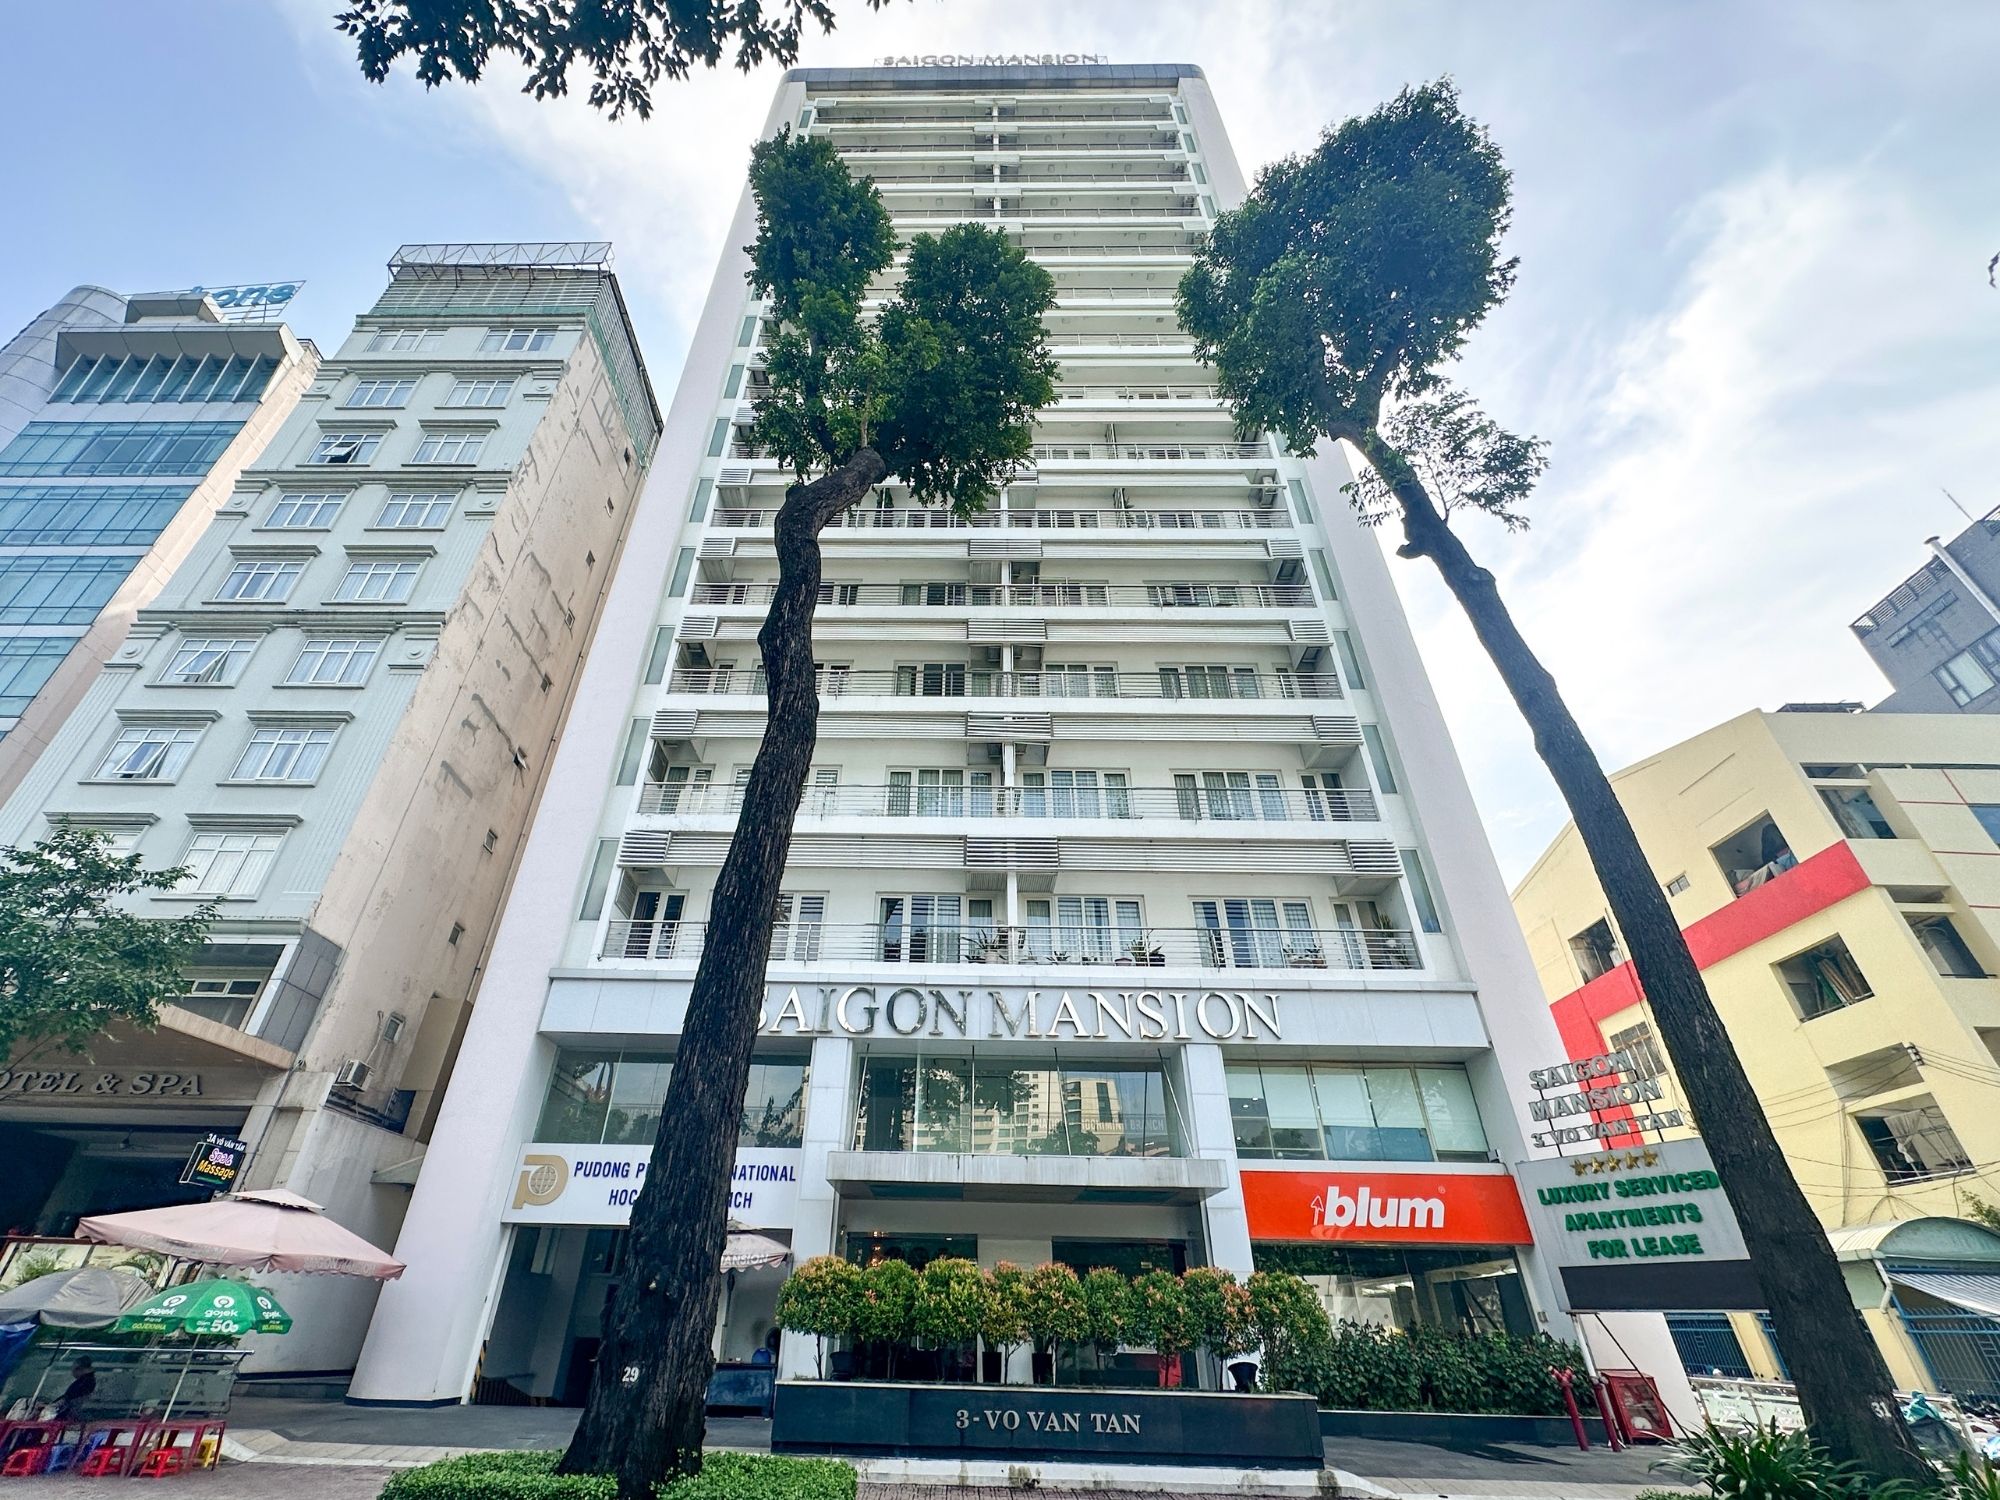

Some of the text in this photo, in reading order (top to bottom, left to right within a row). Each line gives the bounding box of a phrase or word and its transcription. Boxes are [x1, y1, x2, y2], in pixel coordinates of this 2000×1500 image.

[883, 53, 1098, 66] SAIGON MANSION
[192, 284, 296, 308] one
[987, 991, 1283, 1040] MANSION
[1528, 1050, 1634, 1091] SAIGON
[91, 1072, 121, 1095] &
[129, 1074, 202, 1096] SPA
[1528, 1077, 1664, 1122] MANSION
[1531, 1110, 1684, 1148] 3 VO VAN TAN
[196, 1160, 235, 1180] Massage
[573, 1161, 631, 1178] PUDONG
[1537, 1170, 1721, 1205] LUXURY SERVICED
[1324, 1186, 1445, 1228] blum
[1565, 1203, 1703, 1231] APARTMENTS
[1588, 1234, 1704, 1259] FOR LEASE
[720, 1254, 769, 1266] ANSION
[204, 1309, 238, 1318] gojek
[622, 1366, 640, 1383] 29
[1871, 1401, 1892, 1419] 31
[1027, 1411, 1081, 1432] VAN
[1090, 1414, 1141, 1434] TAN
